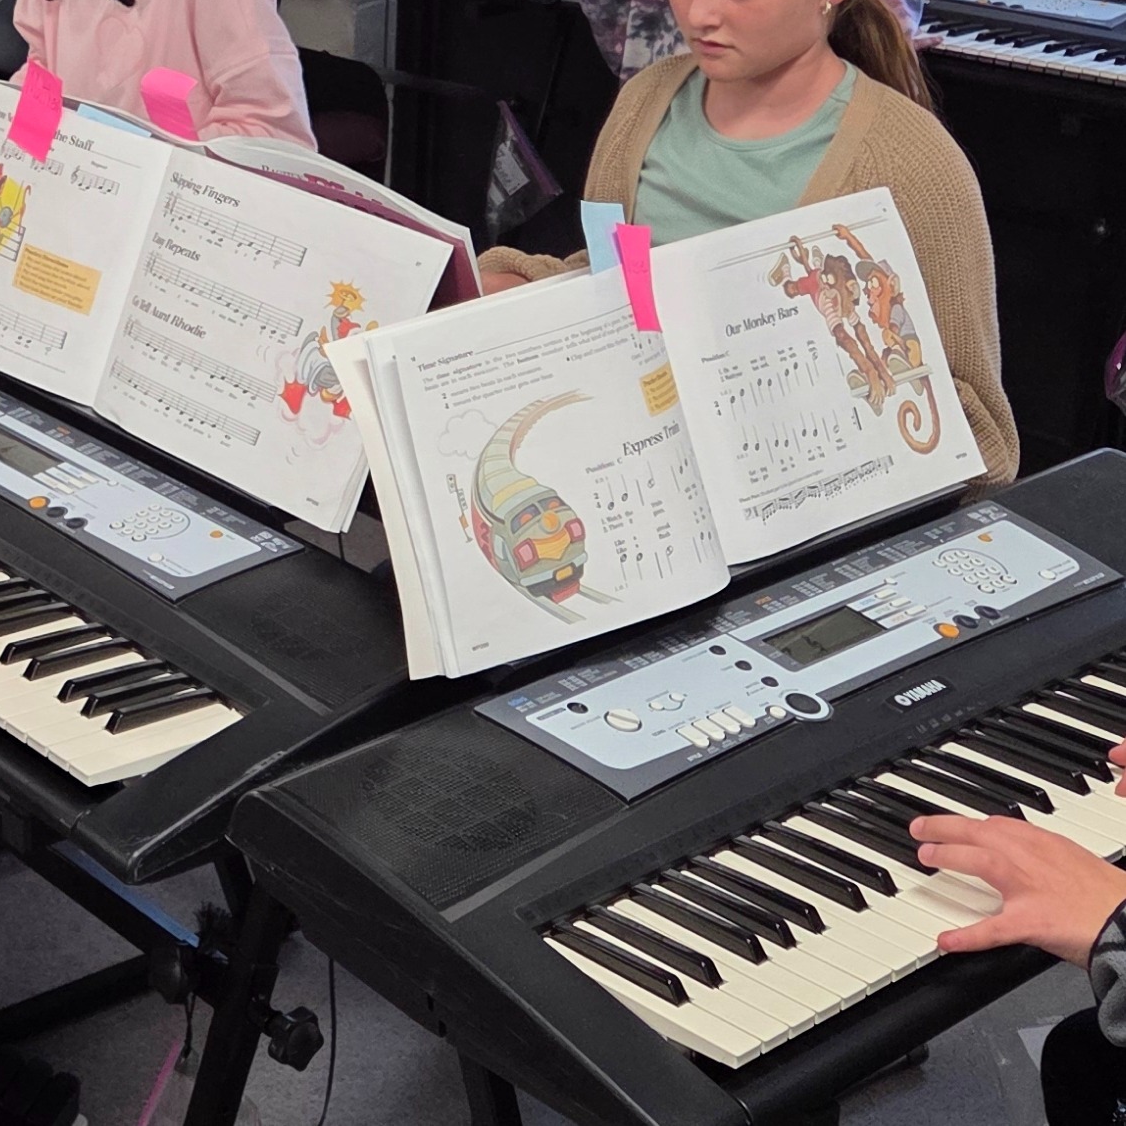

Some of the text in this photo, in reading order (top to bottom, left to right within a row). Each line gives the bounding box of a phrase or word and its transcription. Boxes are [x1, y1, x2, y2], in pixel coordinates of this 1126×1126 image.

[69, 135, 95, 152] Staff
[171, 172, 241, 207] Skipping Fingers
[152, 232, 201, 261] Easy Repeats
[139, 298, 151, 313] Tell
[151, 306, 171, 324] Aunt
[171, 315, 207, 339] Rhodie
[726, 306, 799, 337] Our Monkey Bars
[418, 358, 436, 372] Time
[438, 350, 474, 365] Signature
[623, 432, 664, 456] Express
[902, 679, 947, 702] YAMAHA
